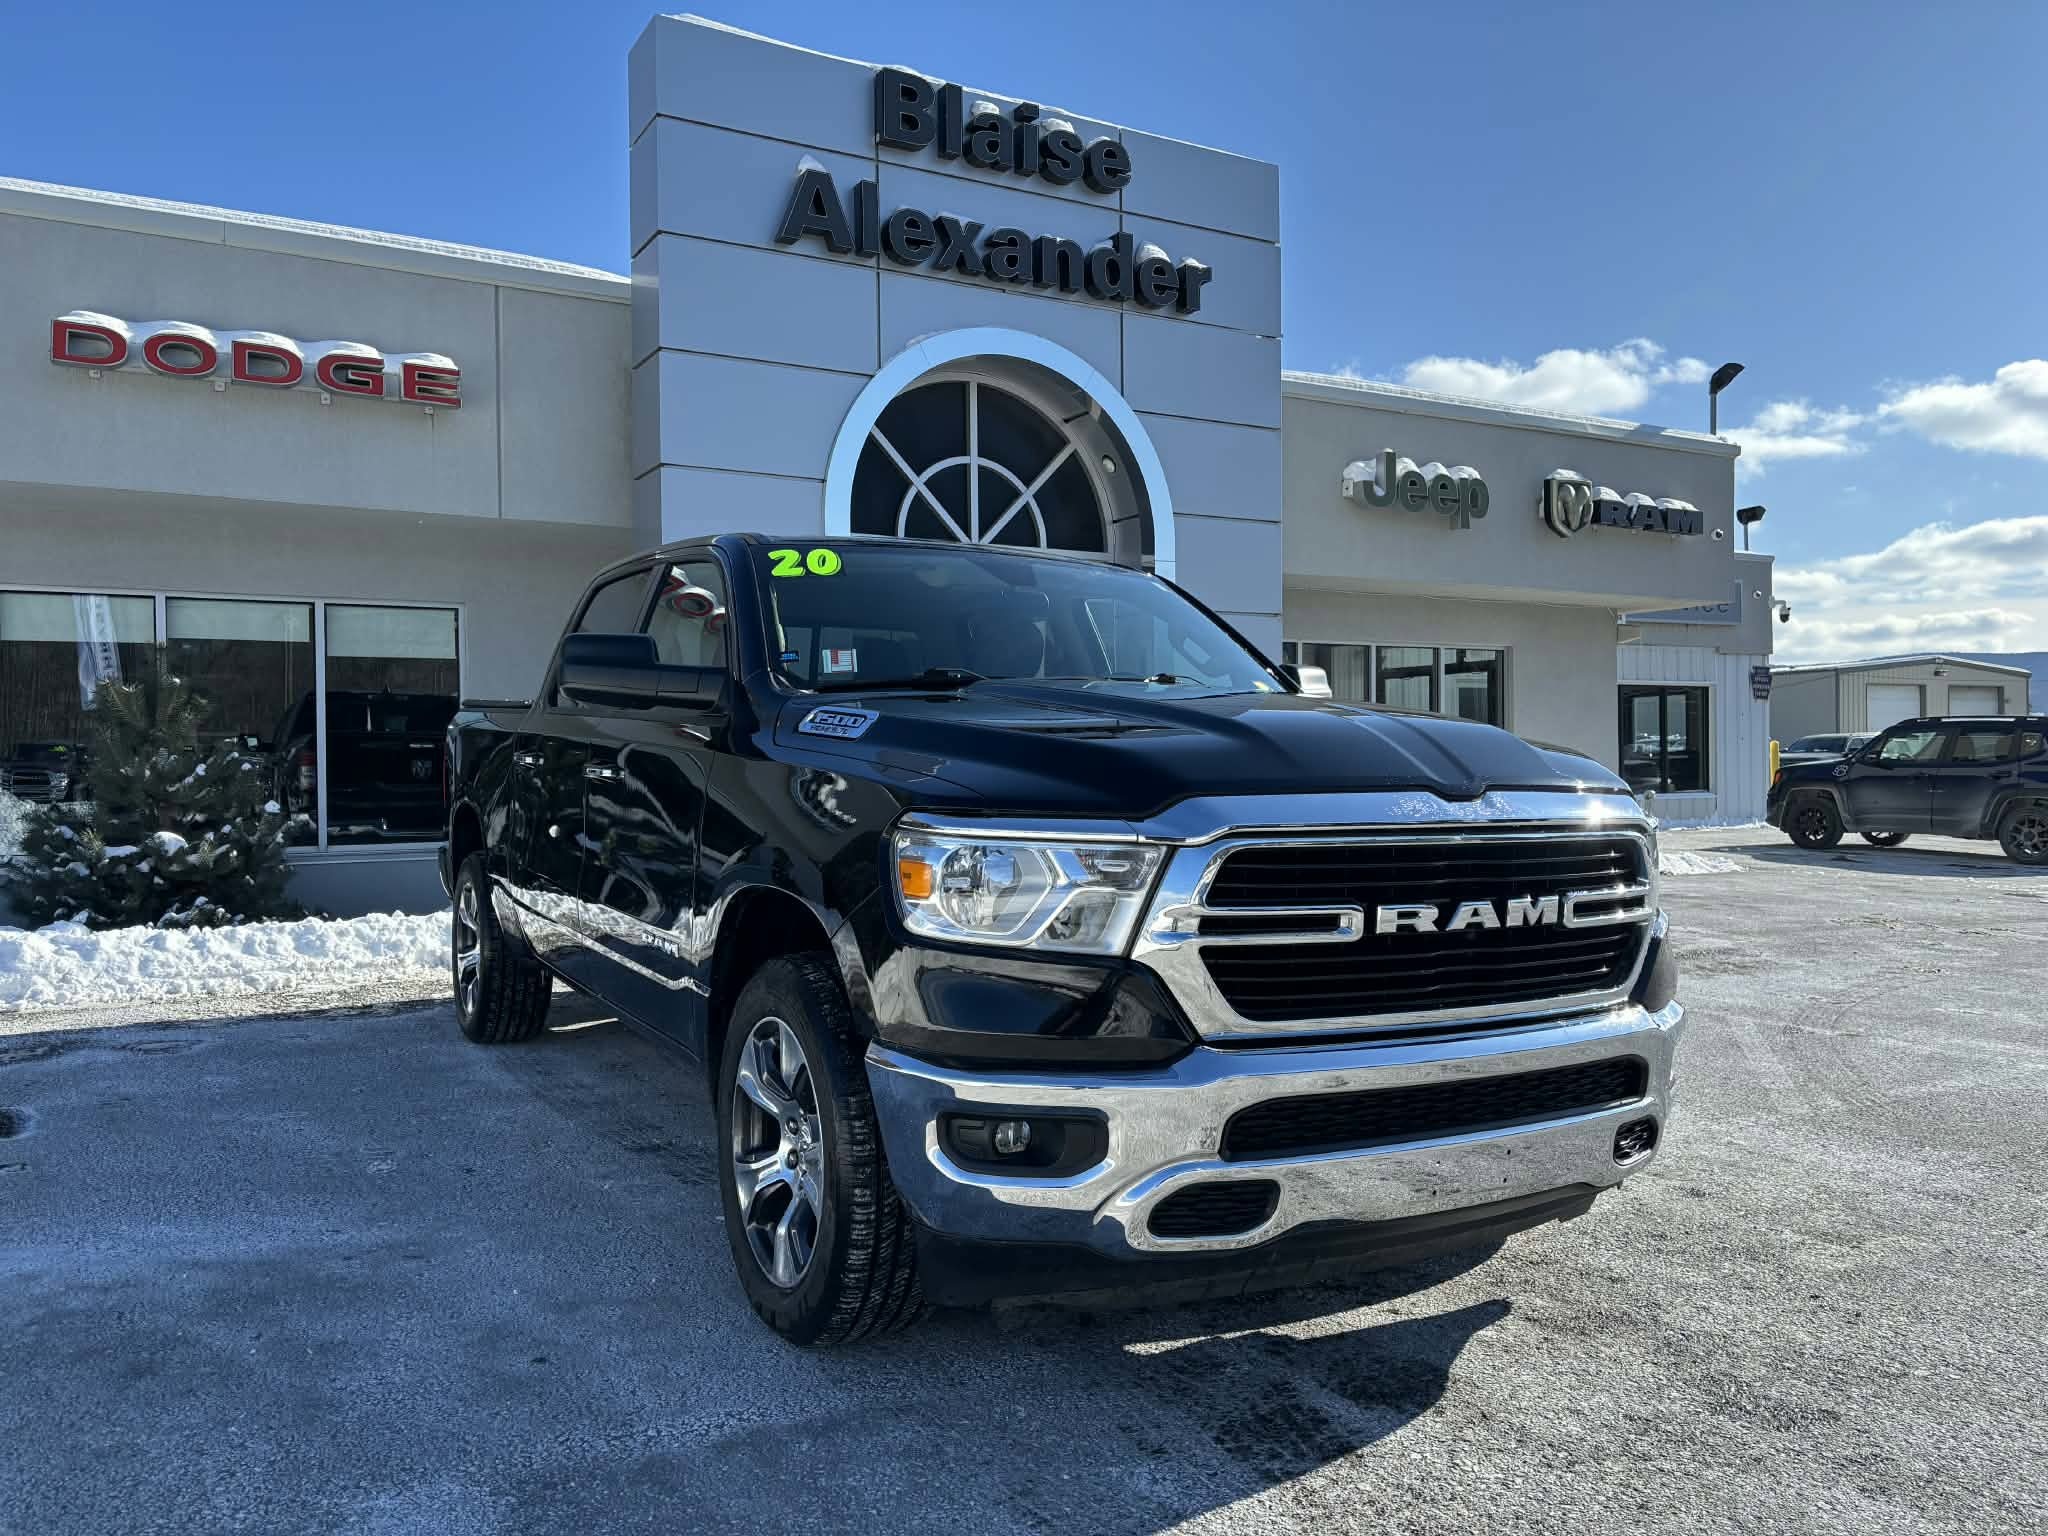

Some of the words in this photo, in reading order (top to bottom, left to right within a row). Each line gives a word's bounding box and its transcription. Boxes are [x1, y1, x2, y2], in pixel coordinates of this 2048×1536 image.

[875, 67, 1131, 194] Blaise
[775, 169, 1212, 314] Alexander
[50, 318, 463, 409] DODGE
[1360, 449, 1490, 530] Jeep
[1592, 499, 1704, 536] RAM
[768, 548, 842, 577] 20
[815, 711, 865, 729] 1500
[1376, 895, 1559, 934] RAM
[642, 932, 680, 959] RAM
